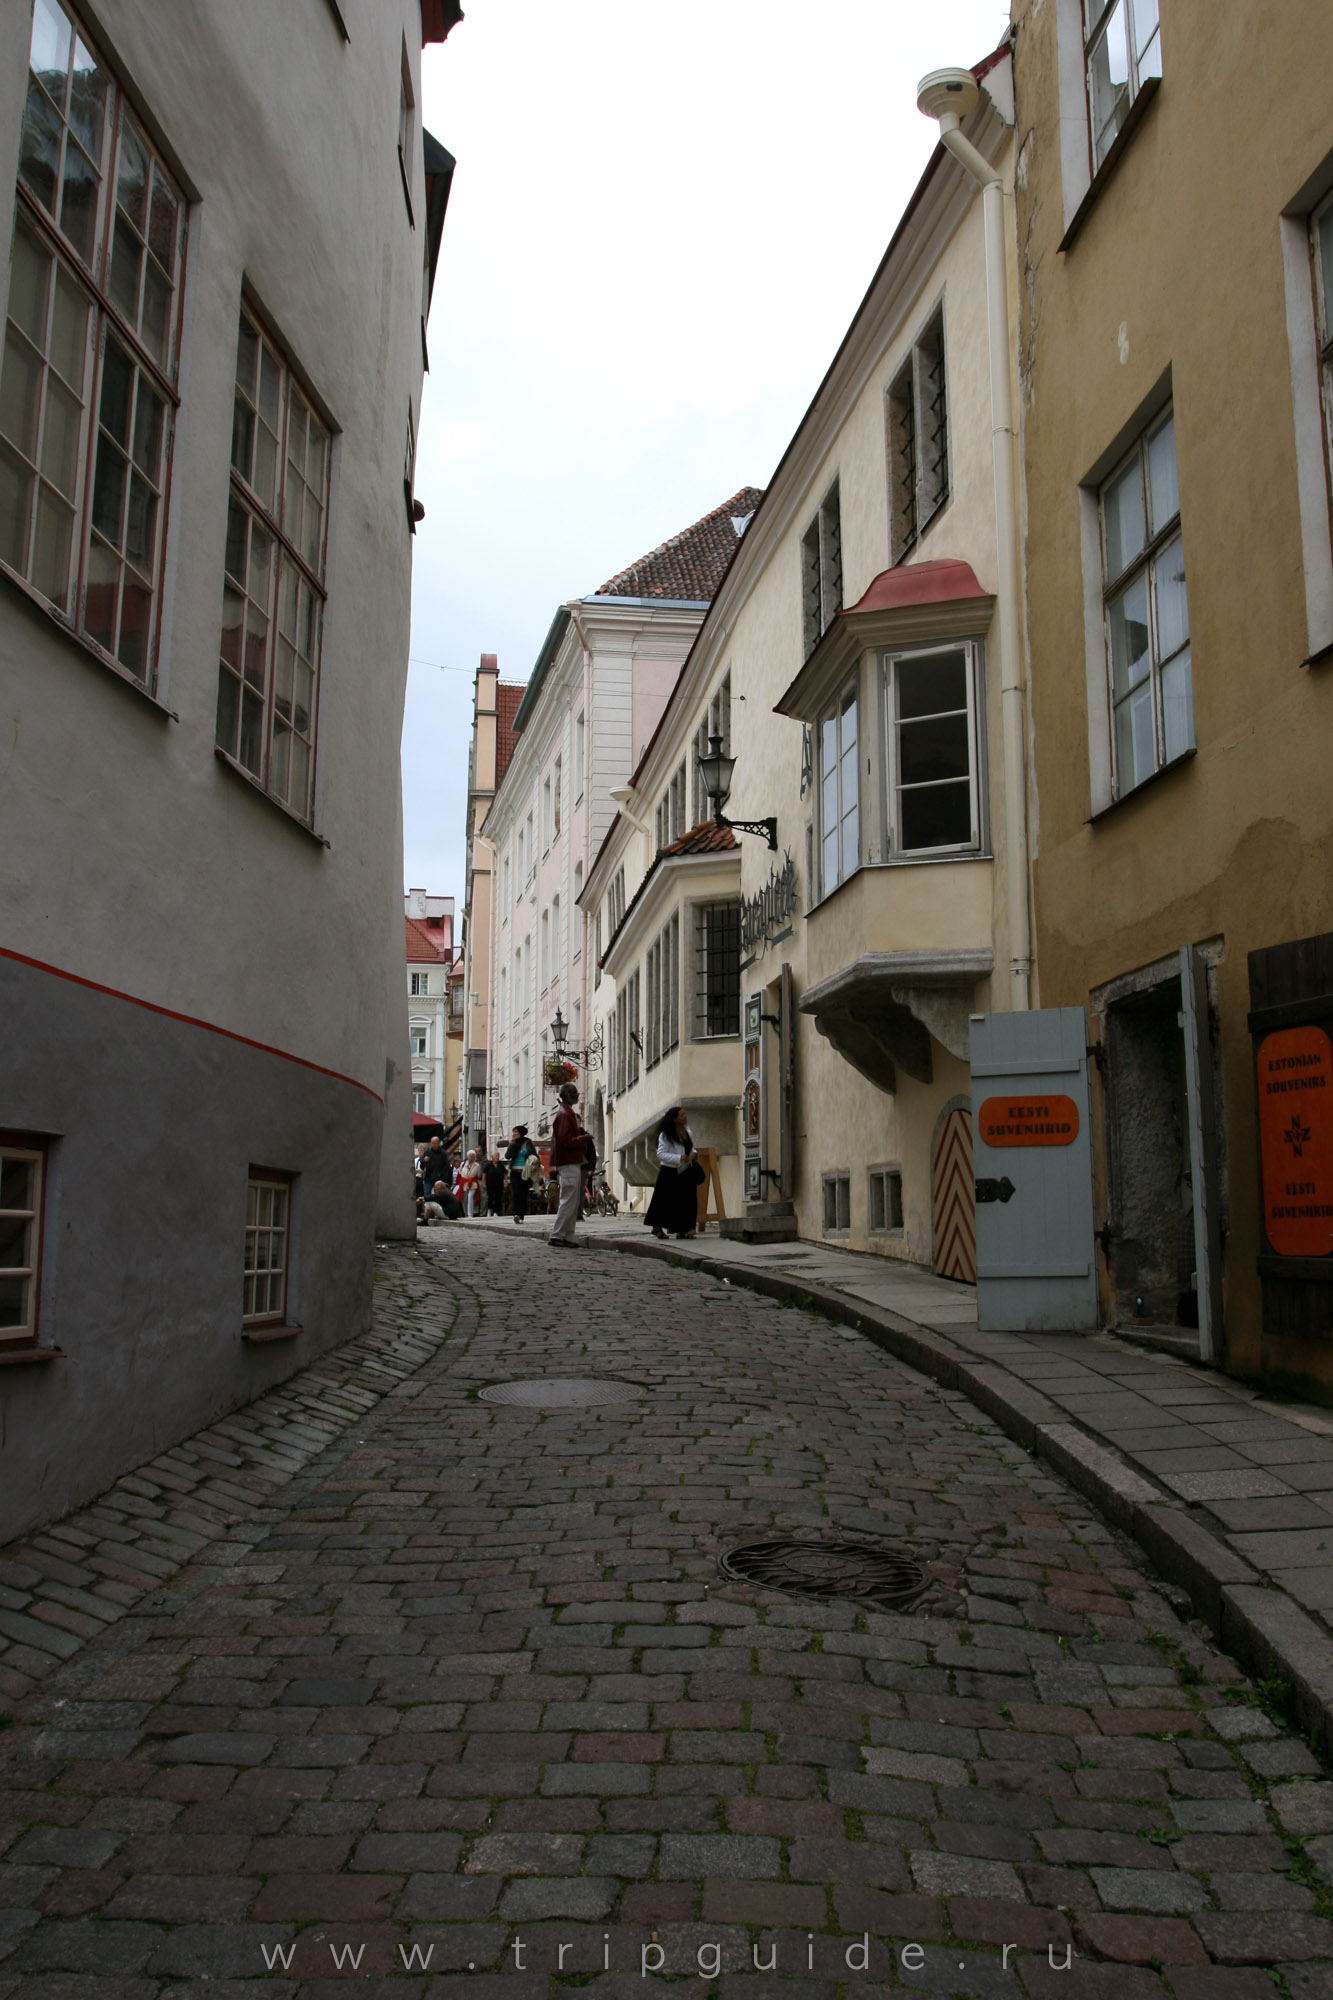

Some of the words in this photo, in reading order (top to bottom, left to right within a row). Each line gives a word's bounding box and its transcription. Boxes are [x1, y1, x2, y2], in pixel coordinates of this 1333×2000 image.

[1268, 1054, 1321, 1072] ESTONIAN
[1266, 1076, 1326, 1094] SOUVENIRS
[1008, 1106, 1049, 1118] EESTI
[987, 1122, 1071, 1136] SUVENIIRID
[1286, 1183, 1316, 1196] EESTI
